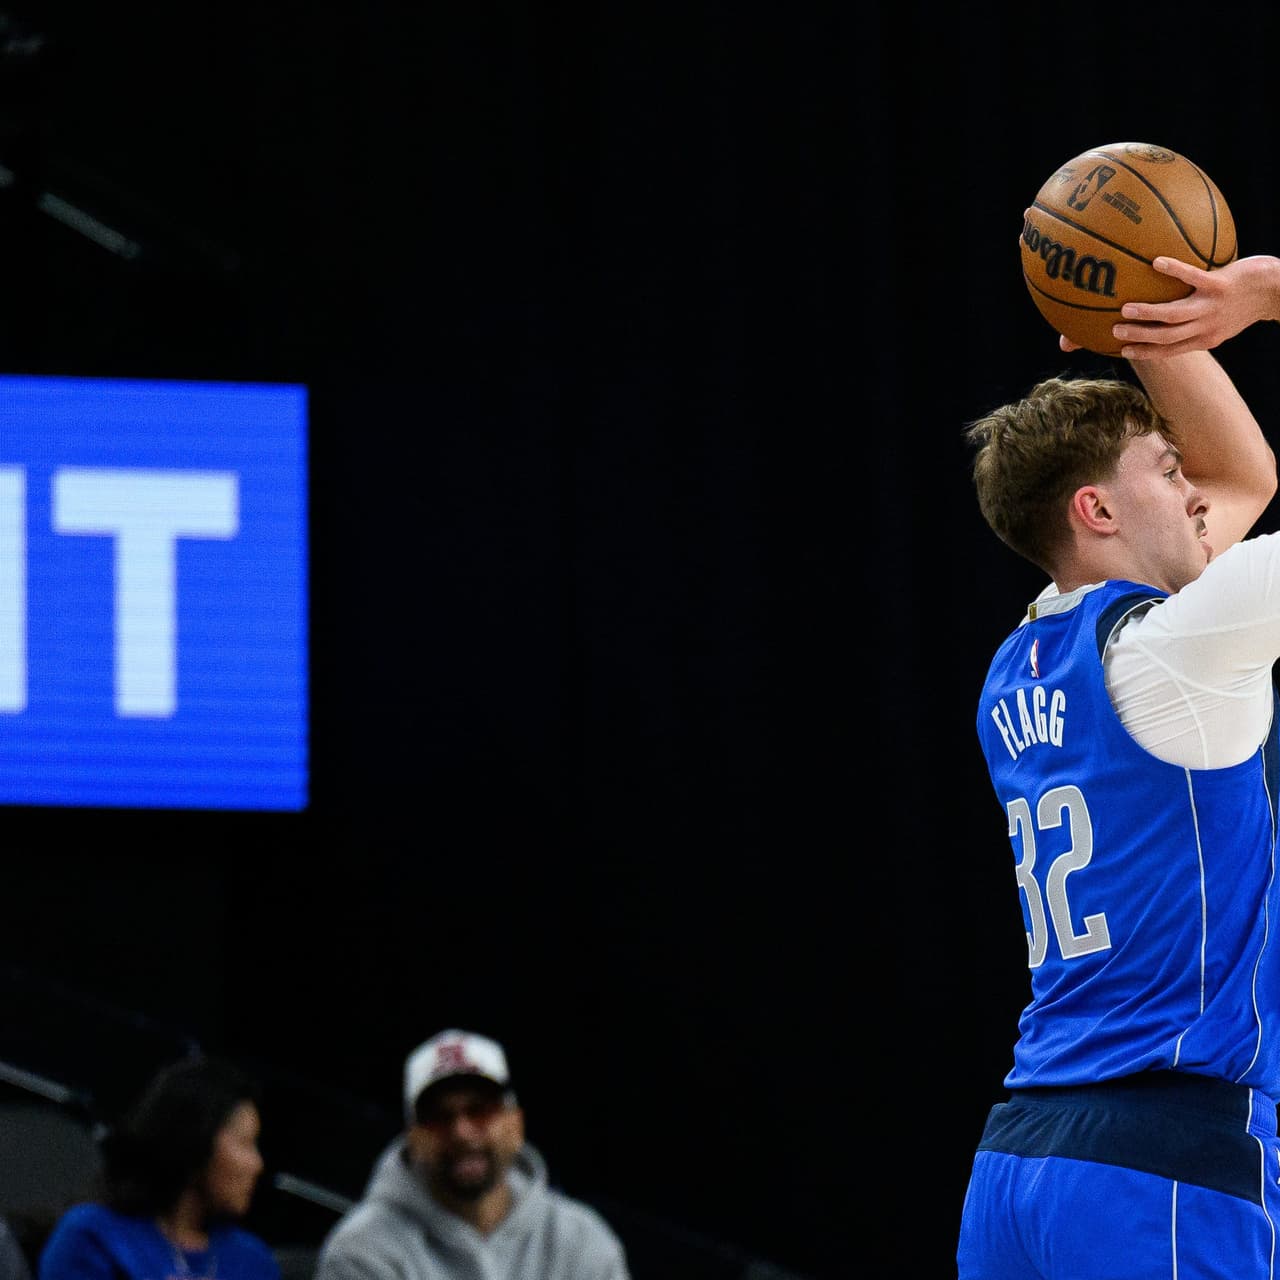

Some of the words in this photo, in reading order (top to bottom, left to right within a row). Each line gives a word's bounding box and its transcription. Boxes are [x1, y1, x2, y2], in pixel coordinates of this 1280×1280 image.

[0, 464, 240, 719] T
[990, 684, 1067, 761] FLAGG
[1006, 784, 1112, 968] 32
